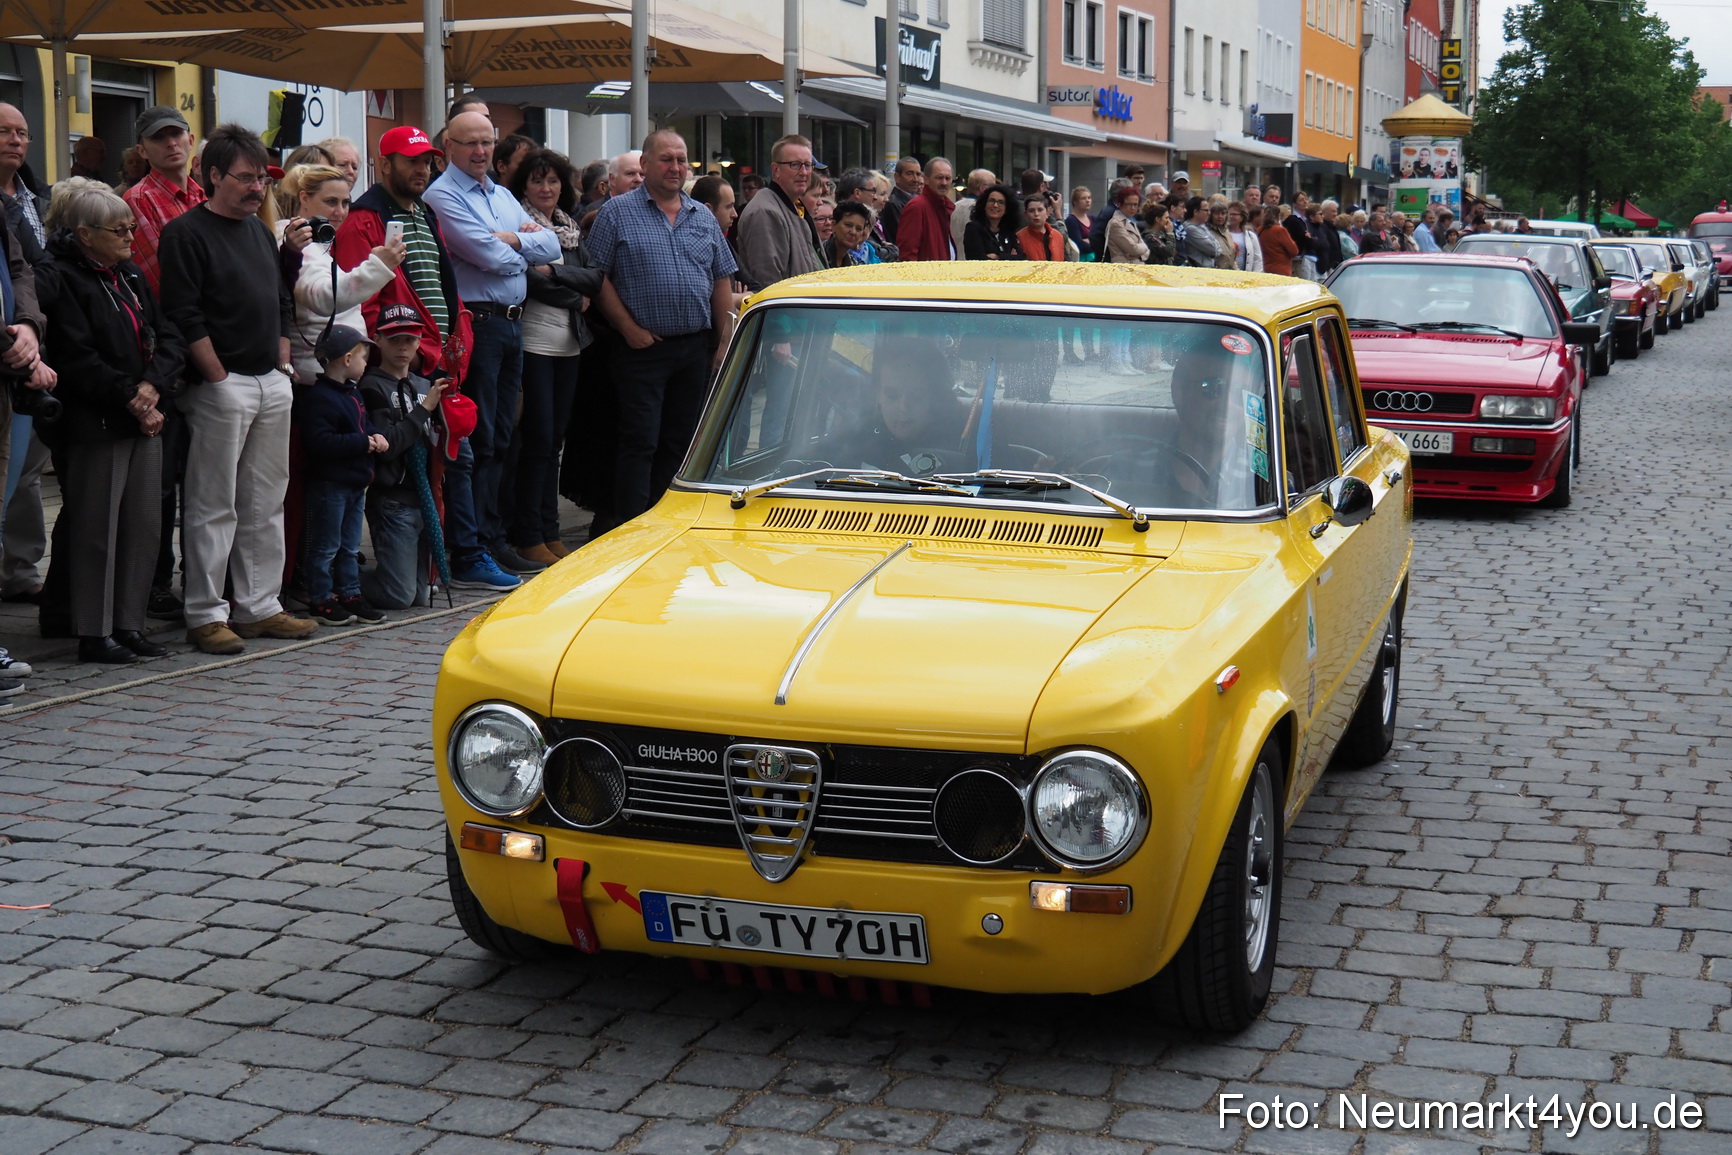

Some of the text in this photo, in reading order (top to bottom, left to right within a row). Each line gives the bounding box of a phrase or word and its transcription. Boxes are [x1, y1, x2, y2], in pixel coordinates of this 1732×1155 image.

[181, 92, 195, 111] 24
[385, 307, 400, 320] NEW
[1412, 433, 1440, 450] 666
[638, 744, 718, 764] GIULIA 1300
[654, 901, 922, 958] D FÜ TY 70H
